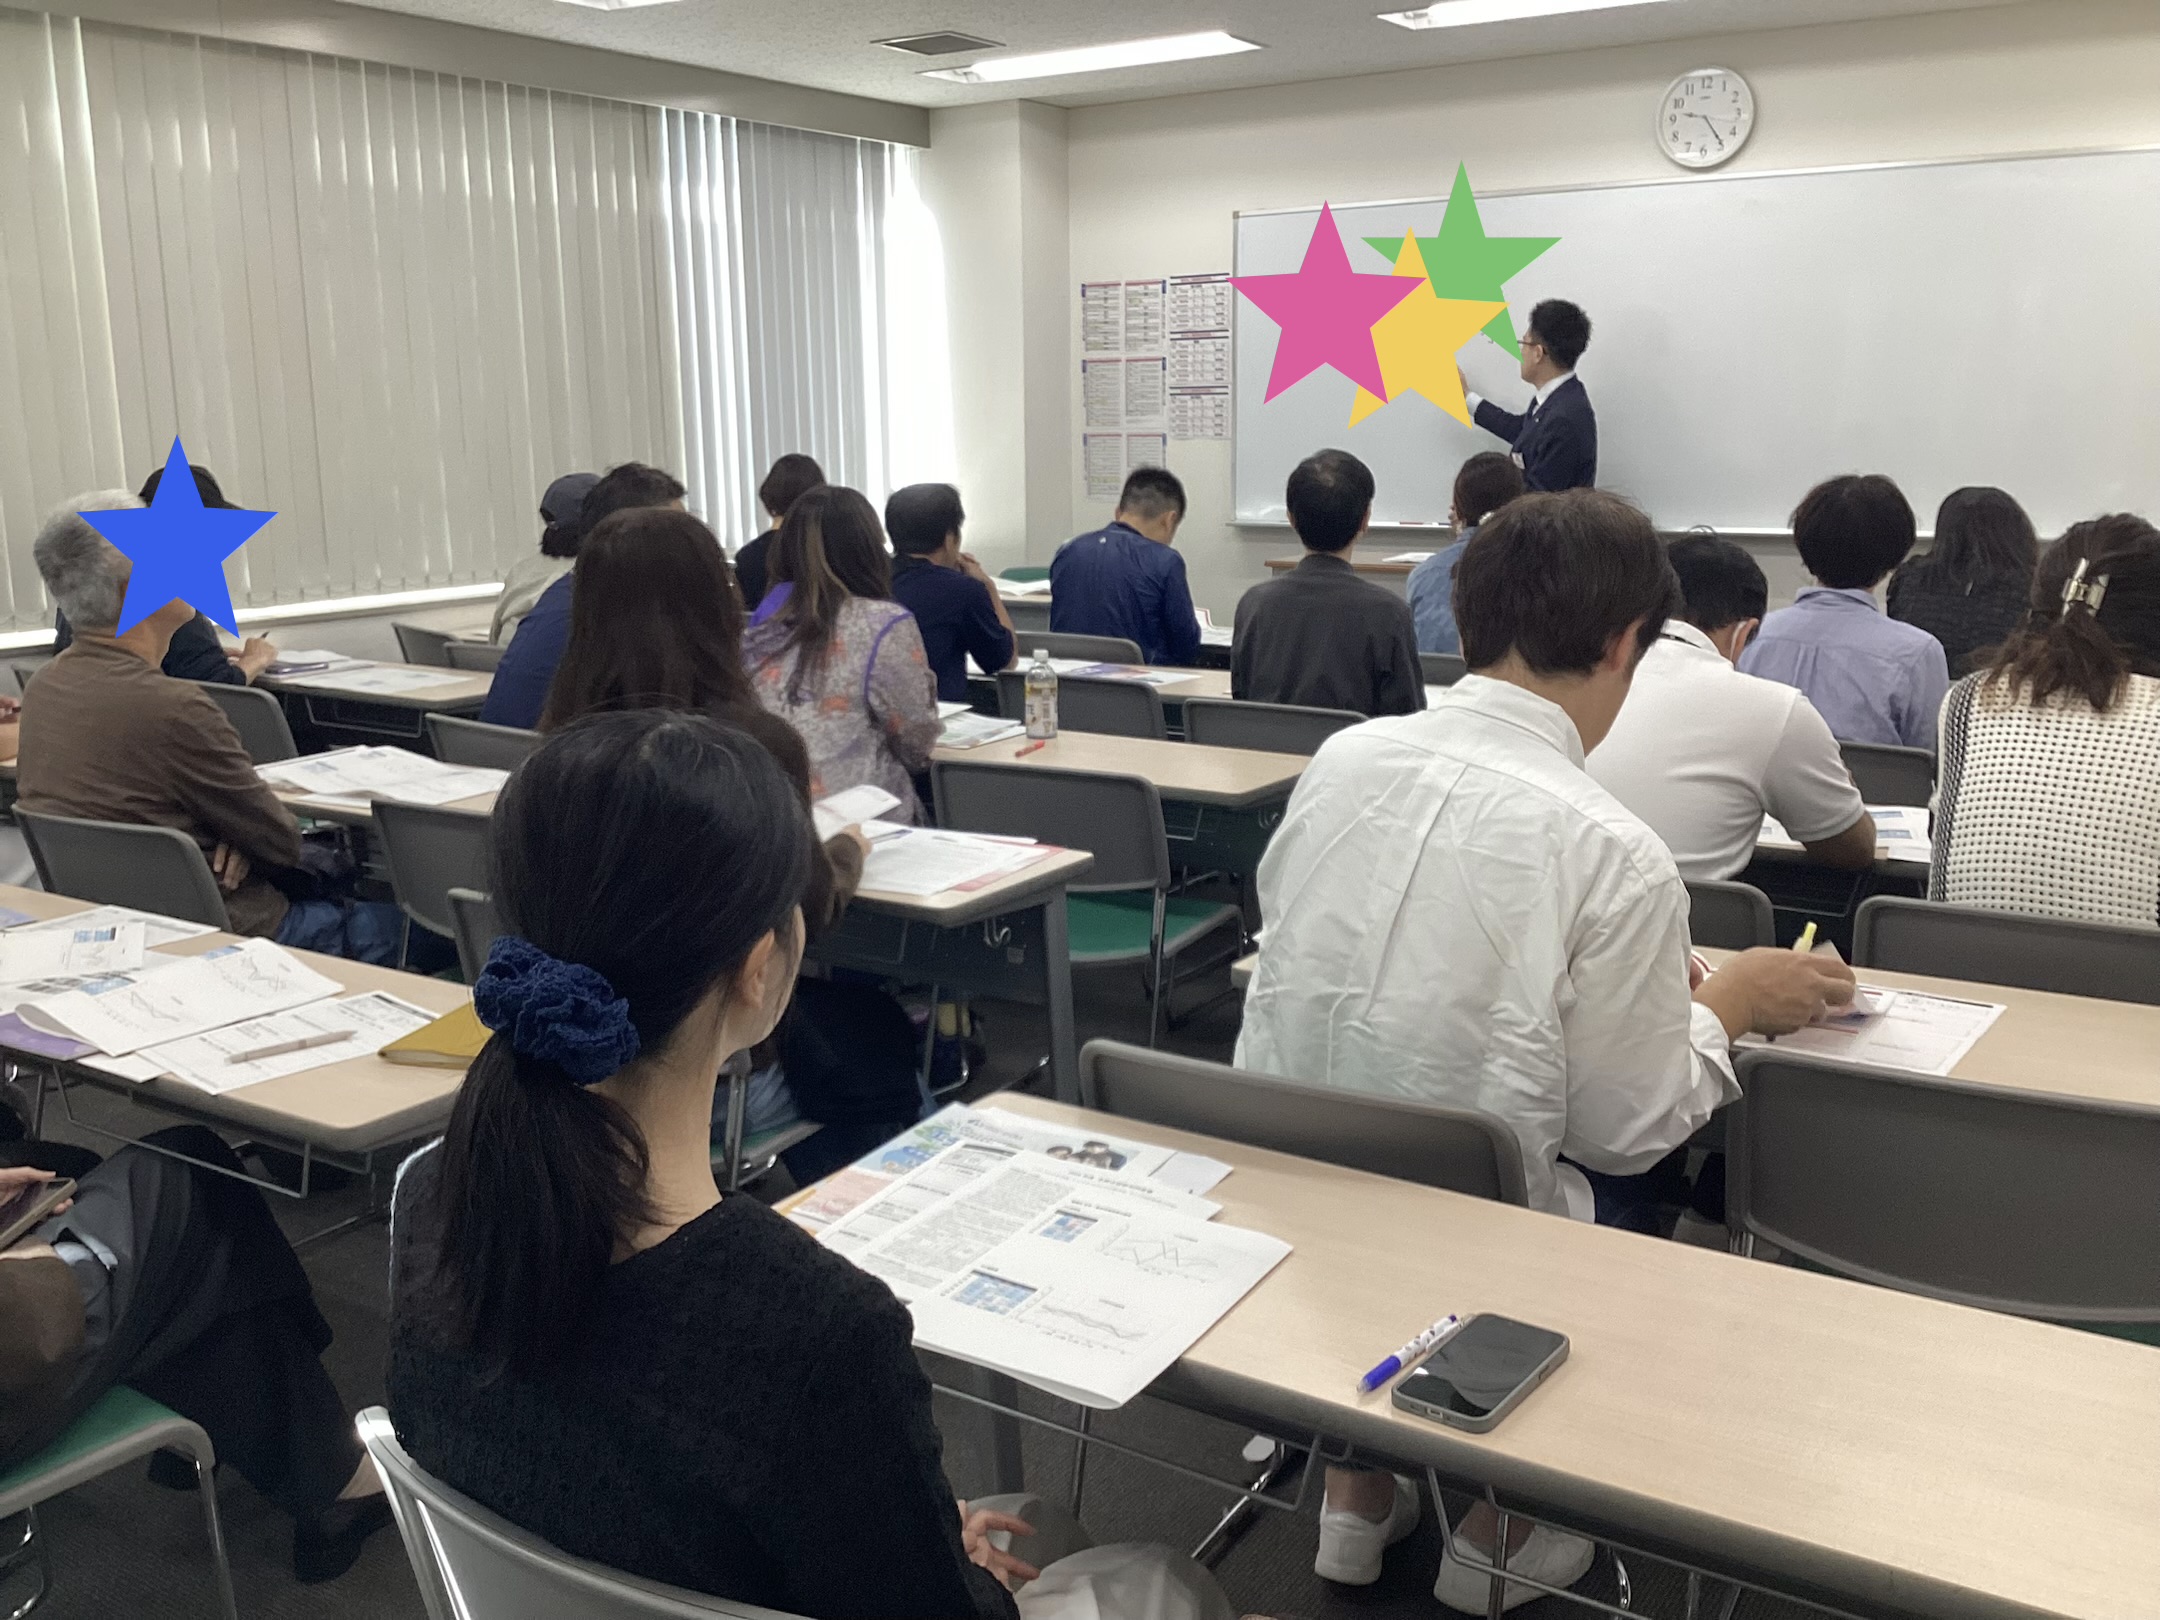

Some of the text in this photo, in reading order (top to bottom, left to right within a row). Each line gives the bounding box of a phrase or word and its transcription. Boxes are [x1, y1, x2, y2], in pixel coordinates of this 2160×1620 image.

[1701, 76, 1713, 89] 12
[1722, 80, 1727, 92] 1
[1685, 83, 1695, 95] 11
[1731, 90, 1739, 103] 2
[1674, 98, 1685, 109] 10
[1669, 113, 1677, 124] 9
[1671, 131, 1679, 142] 8
[1729, 126, 1737, 136] 4
[1684, 142, 1692, 153] 7
[1700, 144, 1708, 157] 6
